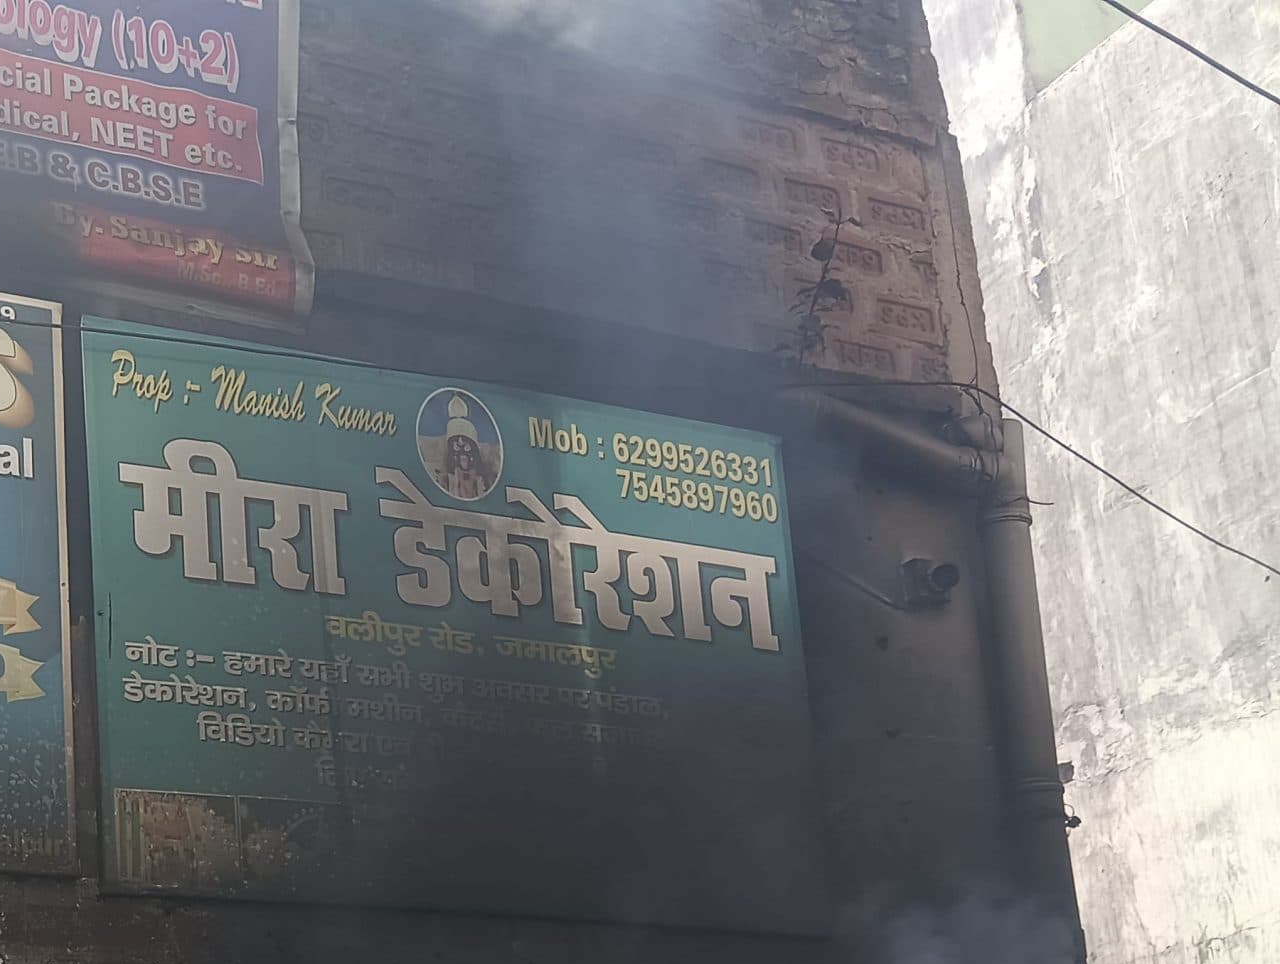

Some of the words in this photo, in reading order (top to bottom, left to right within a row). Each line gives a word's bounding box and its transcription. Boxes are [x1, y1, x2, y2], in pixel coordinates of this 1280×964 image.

[112, 9, 239, 93] (10+2)
[64, 73, 196, 128] Package
[205, 105, 247, 139] for
[91, 117, 173, 157] NEET
[184, 142, 242, 171] etc.
[48, 151, 75, 181] &
[85, 160, 204, 209] C.B.S.E
[110, 215, 224, 265] Sanjay
[110, 350, 174, 414] Prop
[210, 363, 306, 422] Manish
[314, 382, 398, 437] Kumar
[528, 416, 589, 457] Mob
[596, 435, 605, 460] :
[612, 432, 773, 488] 6299526331
[616, 468, 779, 524] 7545897960
[118, 438, 348, 596] मीरा
[375, 465, 781, 653] डेकोरेशन
[124, 634, 180, 667] नोट
[222, 647, 294, 679] हमारे
[493, 633, 619, 681] जमालपुर
[122, 669, 257, 712] डेकोरेशन,
[197, 711, 286, 748] विडियो
